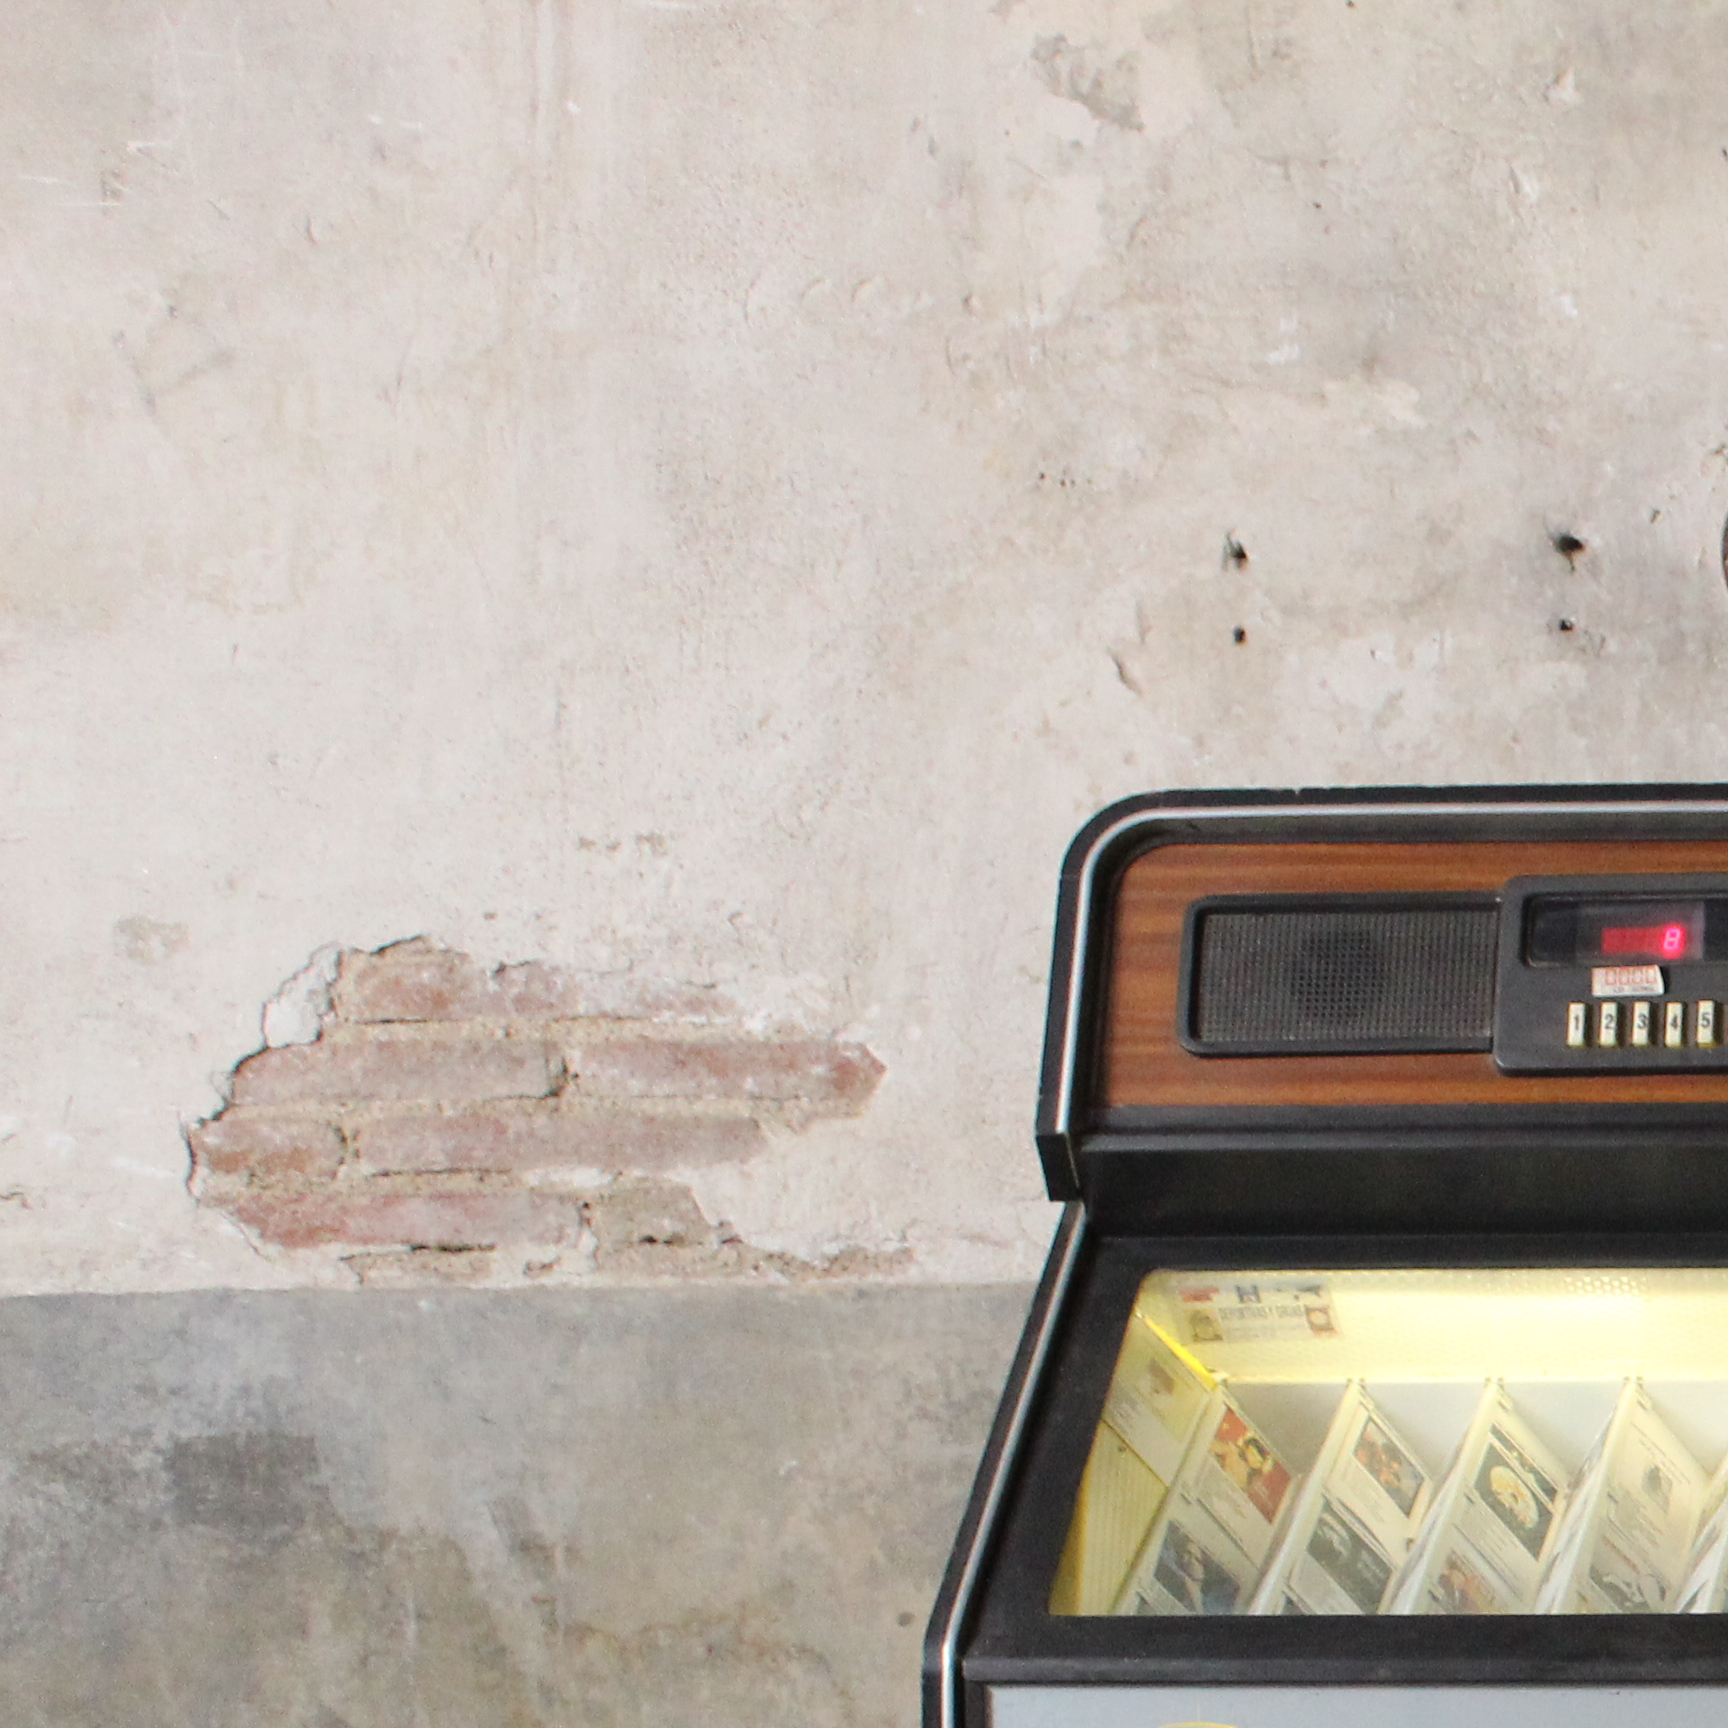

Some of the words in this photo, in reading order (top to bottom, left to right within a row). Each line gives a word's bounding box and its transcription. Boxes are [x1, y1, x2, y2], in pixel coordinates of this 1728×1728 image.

[1663, 927, 1681, 950] 8
[1604, 1014, 1616, 1030] 2
[1637, 1014, 1648, 1030] 3
[1669, 1014, 1680, 1030] 4
[1700, 1011, 1711, 1028] 5
